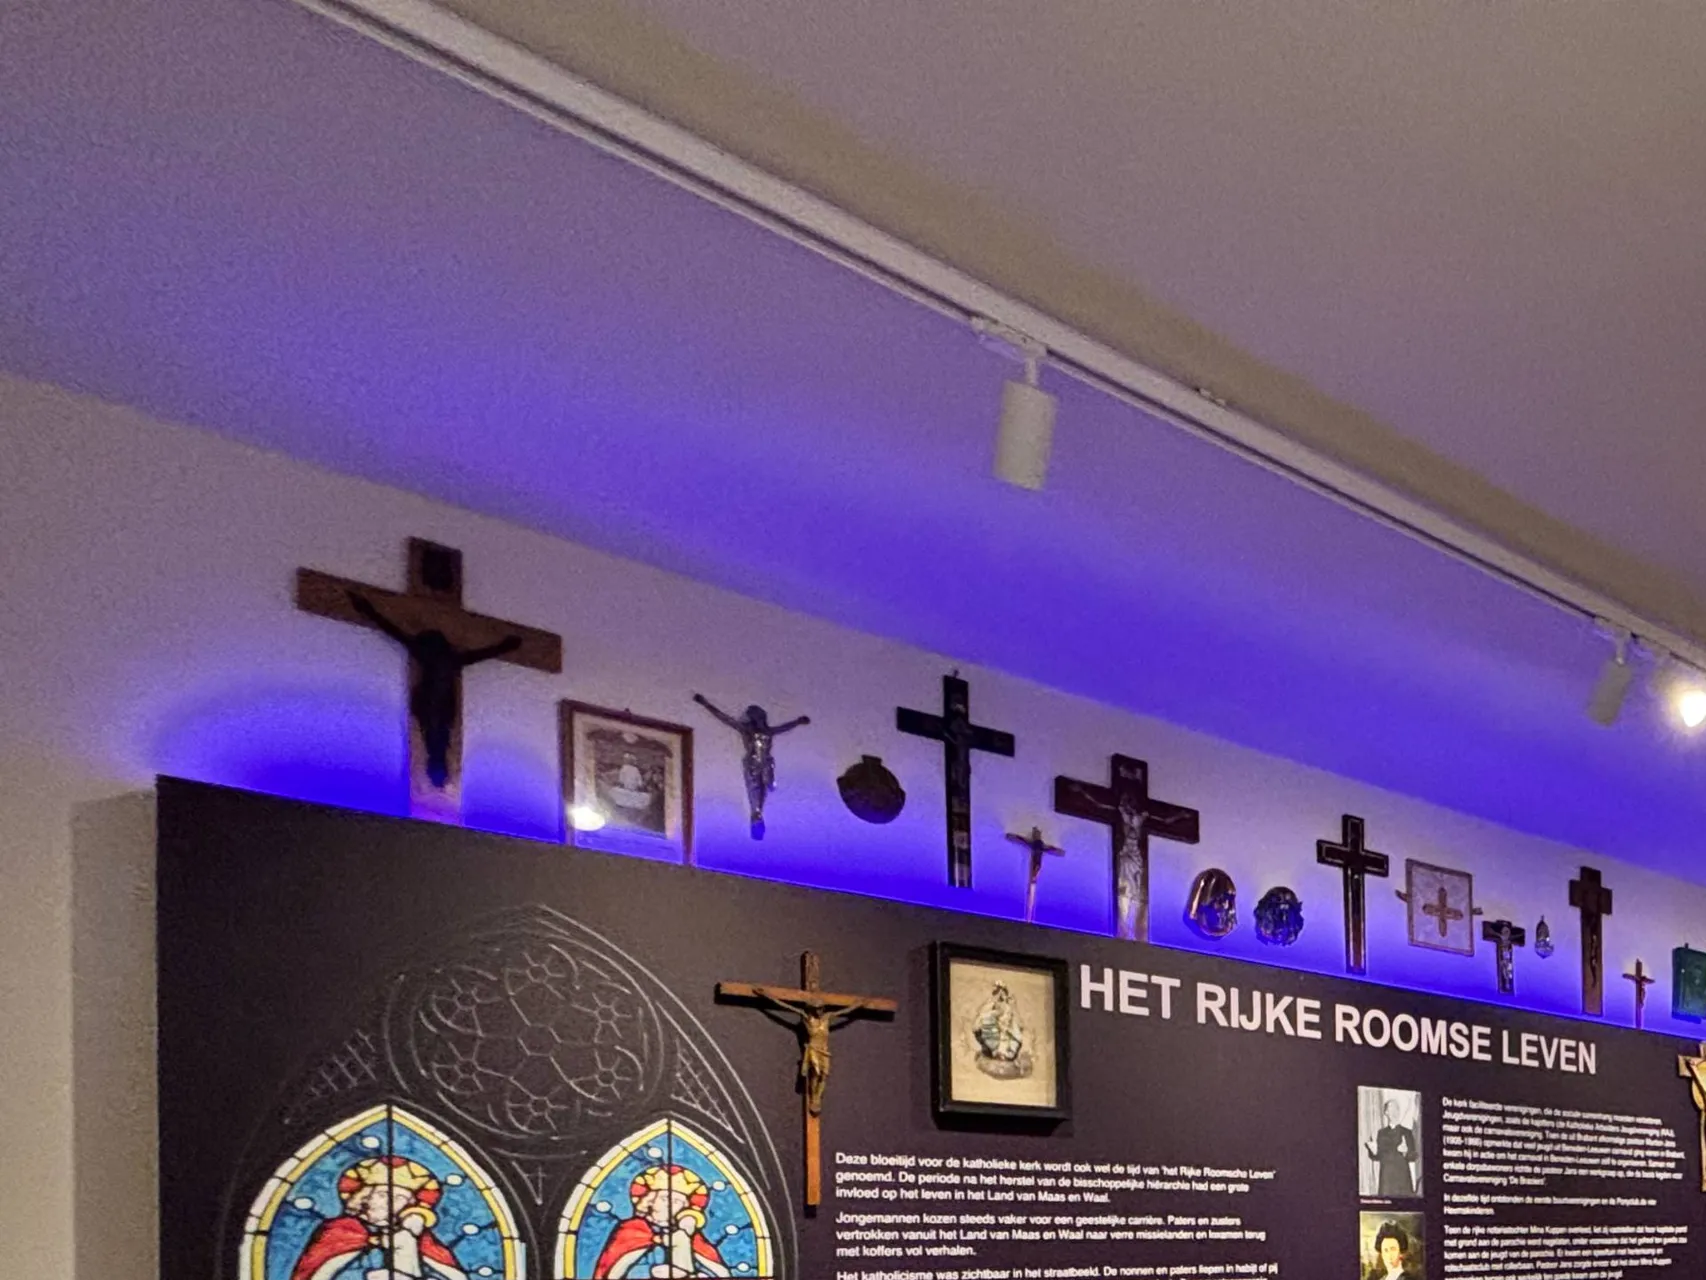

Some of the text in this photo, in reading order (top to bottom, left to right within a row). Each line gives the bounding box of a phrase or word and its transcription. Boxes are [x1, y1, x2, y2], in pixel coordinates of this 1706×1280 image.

[1080, 964, 1597, 1075] HET RIJKE ROOMSE LEVEN
